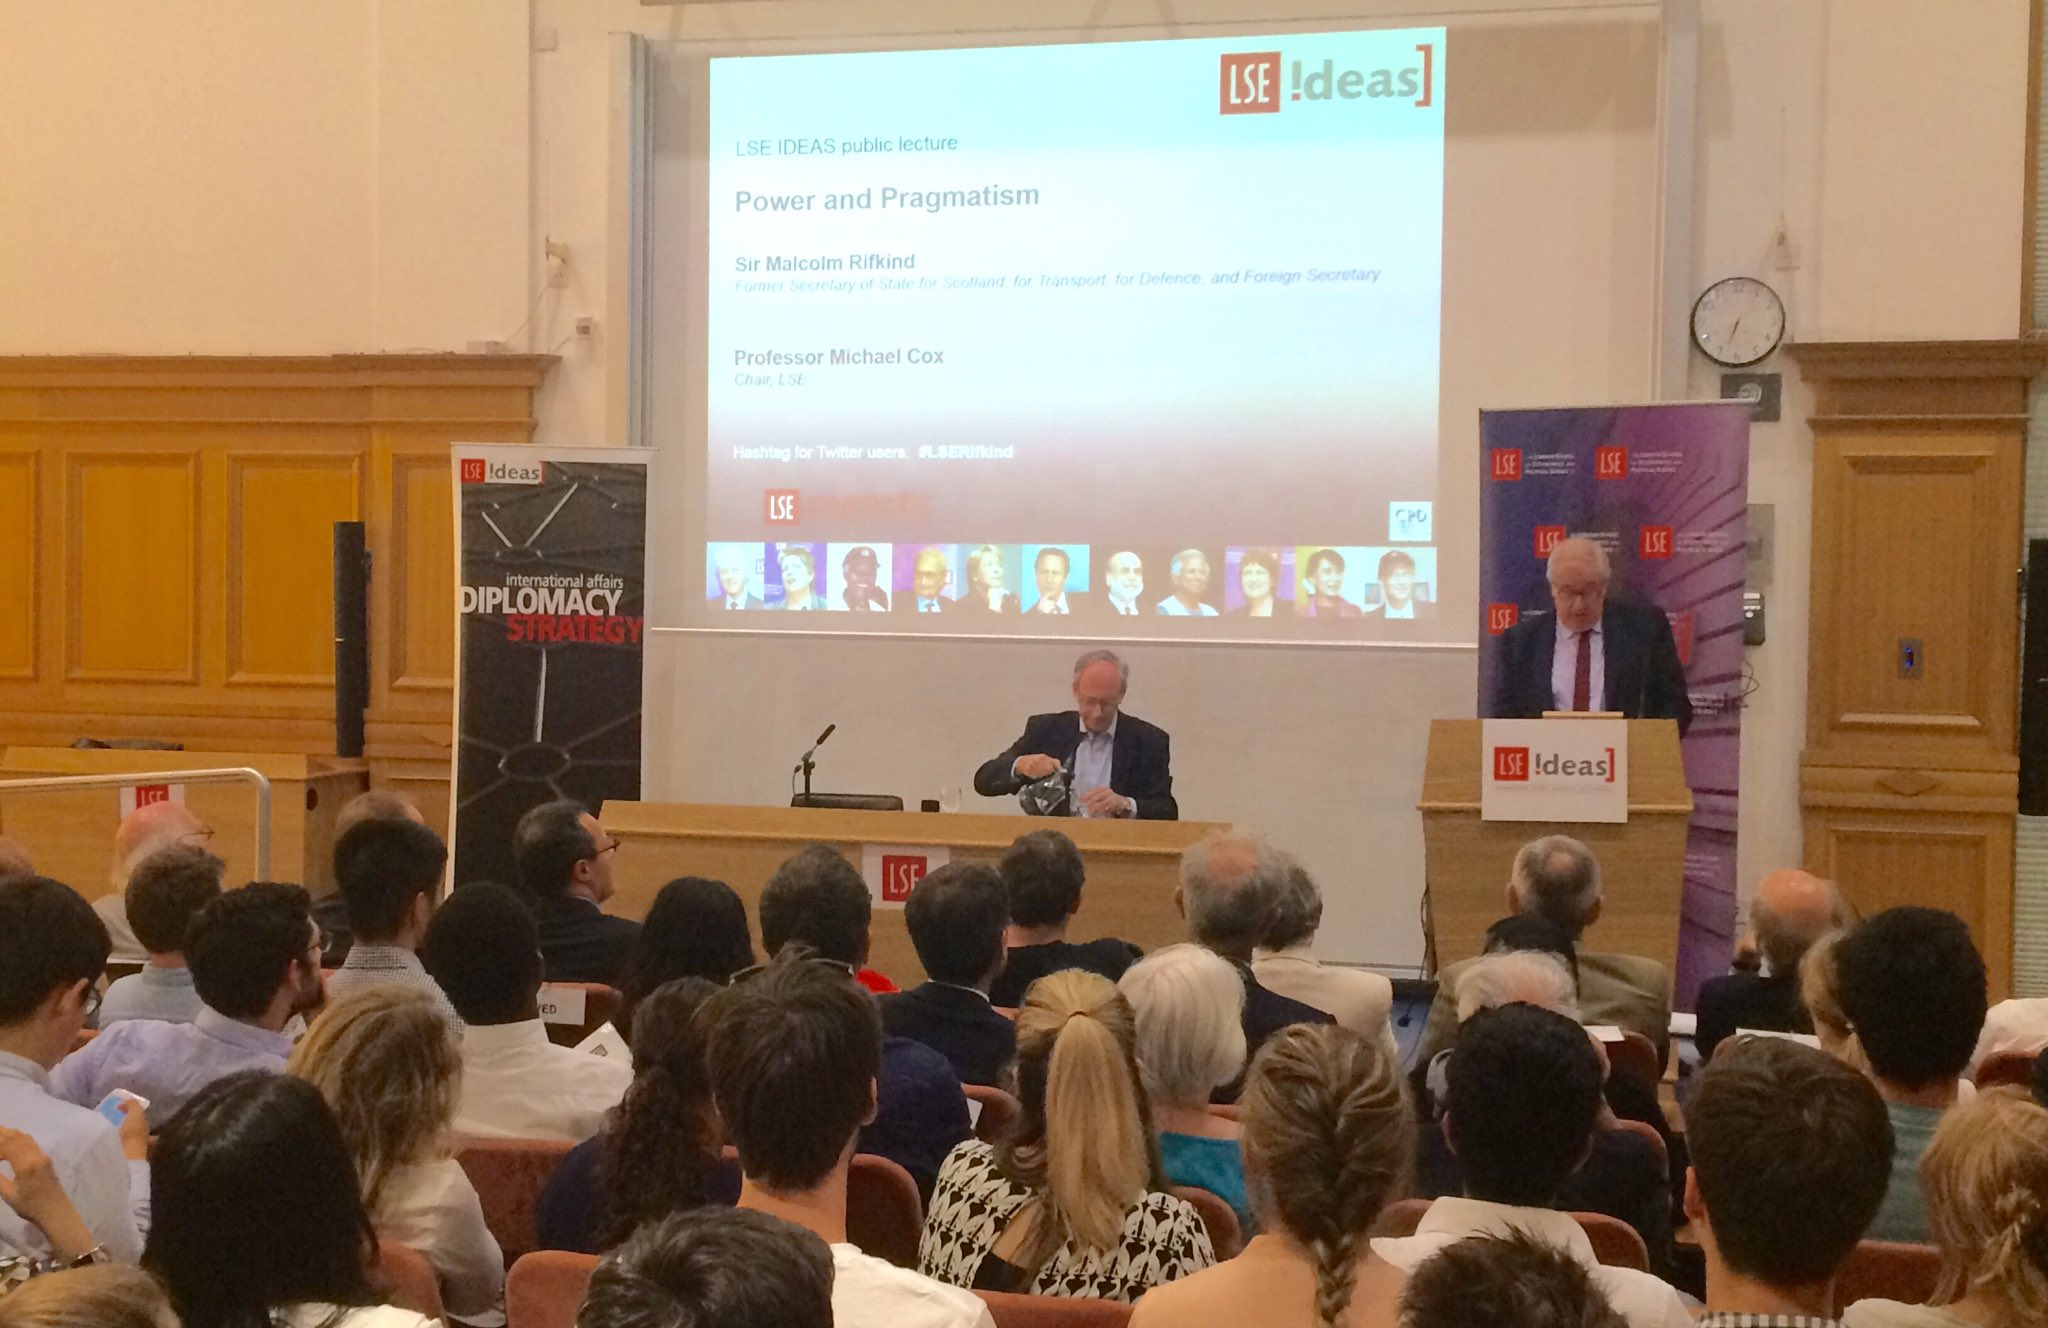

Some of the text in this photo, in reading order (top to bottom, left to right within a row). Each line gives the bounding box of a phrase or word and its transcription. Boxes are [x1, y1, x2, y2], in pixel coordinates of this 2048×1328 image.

[1229, 62, 1271, 105] LSE
[735, 135, 959, 157] LSE IDEAS public lecture
[735, 184, 1040, 213] Power and Pragmatism
[735, 253, 916, 272] Sir Malcolm Rifkind
[734, 278, 784, 292] Former
[789, 278, 855, 294] Secretary
[860, 277, 874, 290] of
[879, 277, 915, 291] State
[919, 276, 938, 289] for
[1013, 274, 1033, 288] for
[1115, 272, 1134, 286] for
[1210, 270, 1240, 285] and
[1243, 269, 1302, 287] Foreign
[1306, 267, 1382, 285] Secretary
[734, 347, 945, 366] Professor Michael Cox
[733, 372, 807, 387] Chair, LSE
[732, 445, 791, 462] Hashtag
[794, 444, 813, 459] for
[816, 444, 863, 460] Twitter
[917, 444, 1014, 460] #LSERifkind
[1495, 453, 1517, 475] LSE
[1600, 451, 1622, 474] LSE
[463, 461, 482, 479] LSE
[769, 495, 794, 521] LSE
[1538, 531, 1560, 553] LSE
[1644, 530, 1668, 553] LSE
[505, 572, 624, 589] international affairs
[460, 586, 624, 616] DIPLOMACY
[506, 613, 645, 644] STRATEGY
[1491, 608, 1512, 630] LSE
[1499, 752, 1524, 776] LSE
